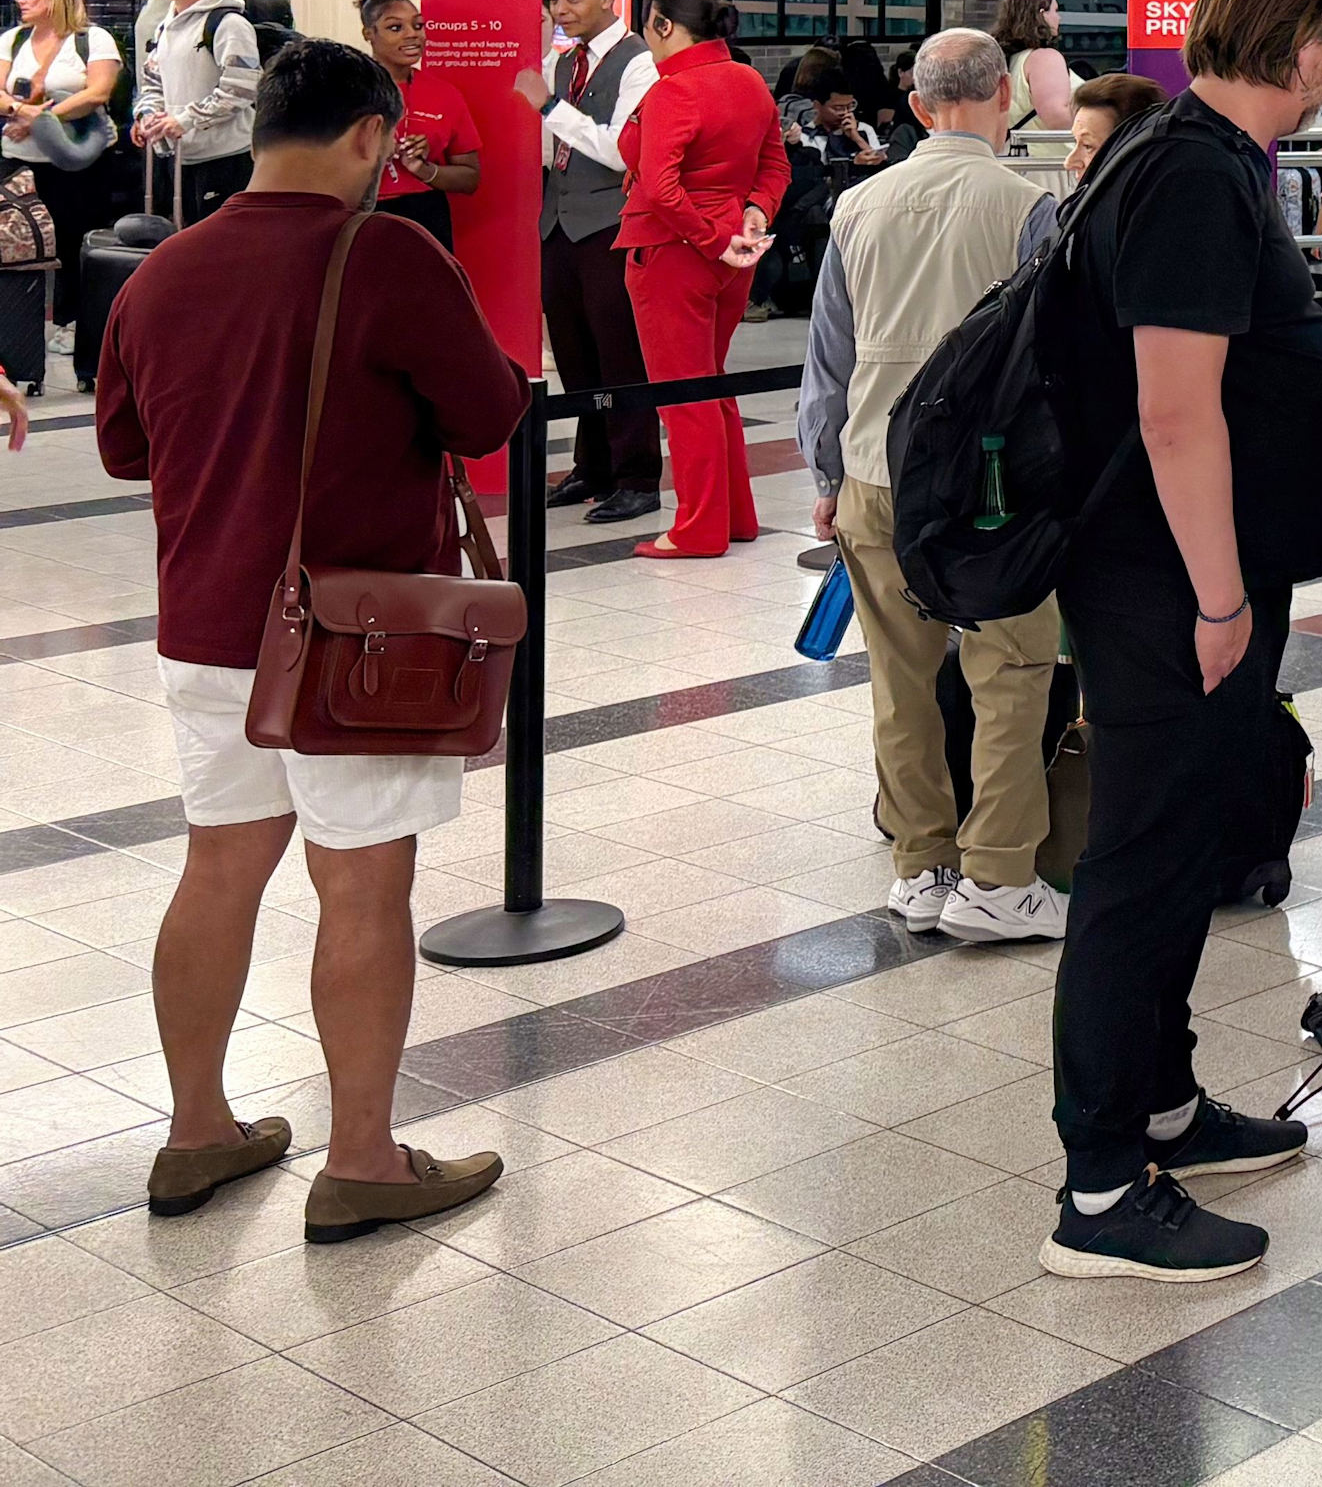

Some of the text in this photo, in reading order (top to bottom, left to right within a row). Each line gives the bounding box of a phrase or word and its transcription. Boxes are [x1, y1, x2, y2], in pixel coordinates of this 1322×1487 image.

[1146, 1, 1195, 18] SKY
[425, 20, 468, 31] Groups
[471, 20, 478, 30] 5
[489, 20, 502, 31] 10
[1146, 20, 1186, 35] PRI
[486, 41, 505, 49] keep
[593, 393, 612, 410] T4
[1014, 891, 1045, 918] N
